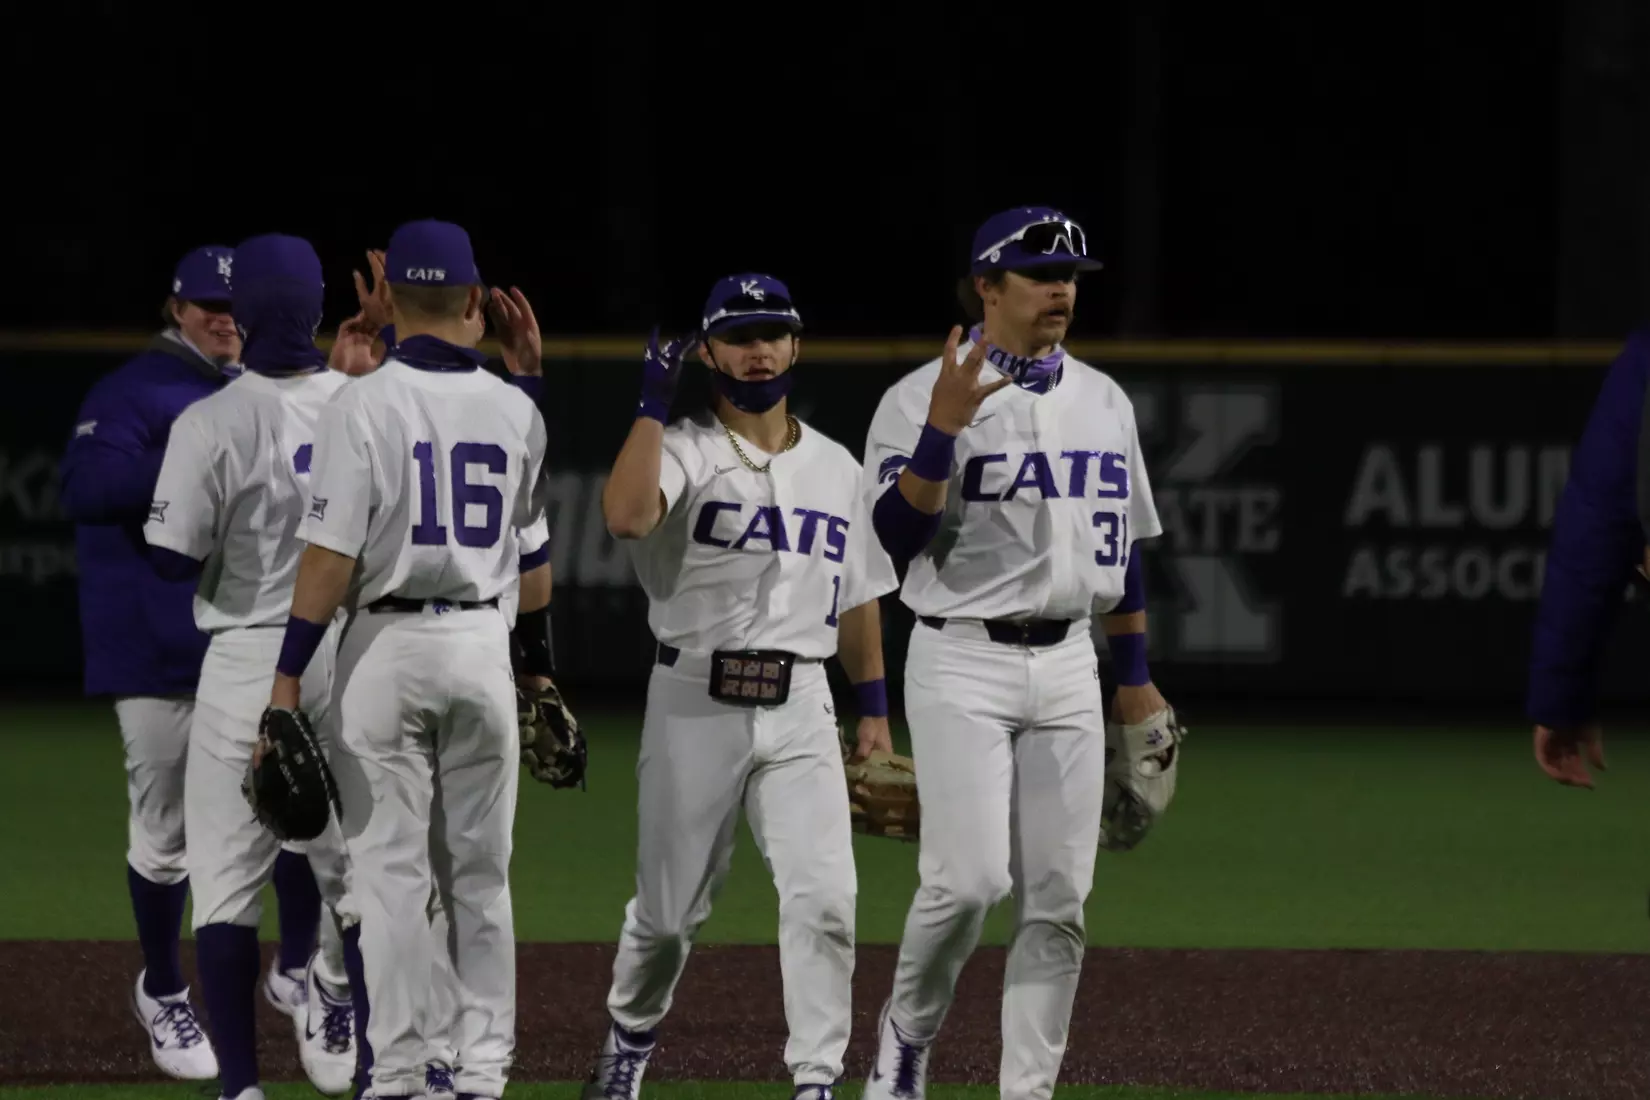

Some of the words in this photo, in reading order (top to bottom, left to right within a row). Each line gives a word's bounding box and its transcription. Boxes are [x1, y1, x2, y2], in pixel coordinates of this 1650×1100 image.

[406, 267, 446, 281] CATS
[411, 440, 507, 549] 16
[961, 449, 1129, 502] CATS
[693, 500, 850, 563] CATS
[1142, 486, 1283, 553] ATE
[825, 575, 840, 628] 1
